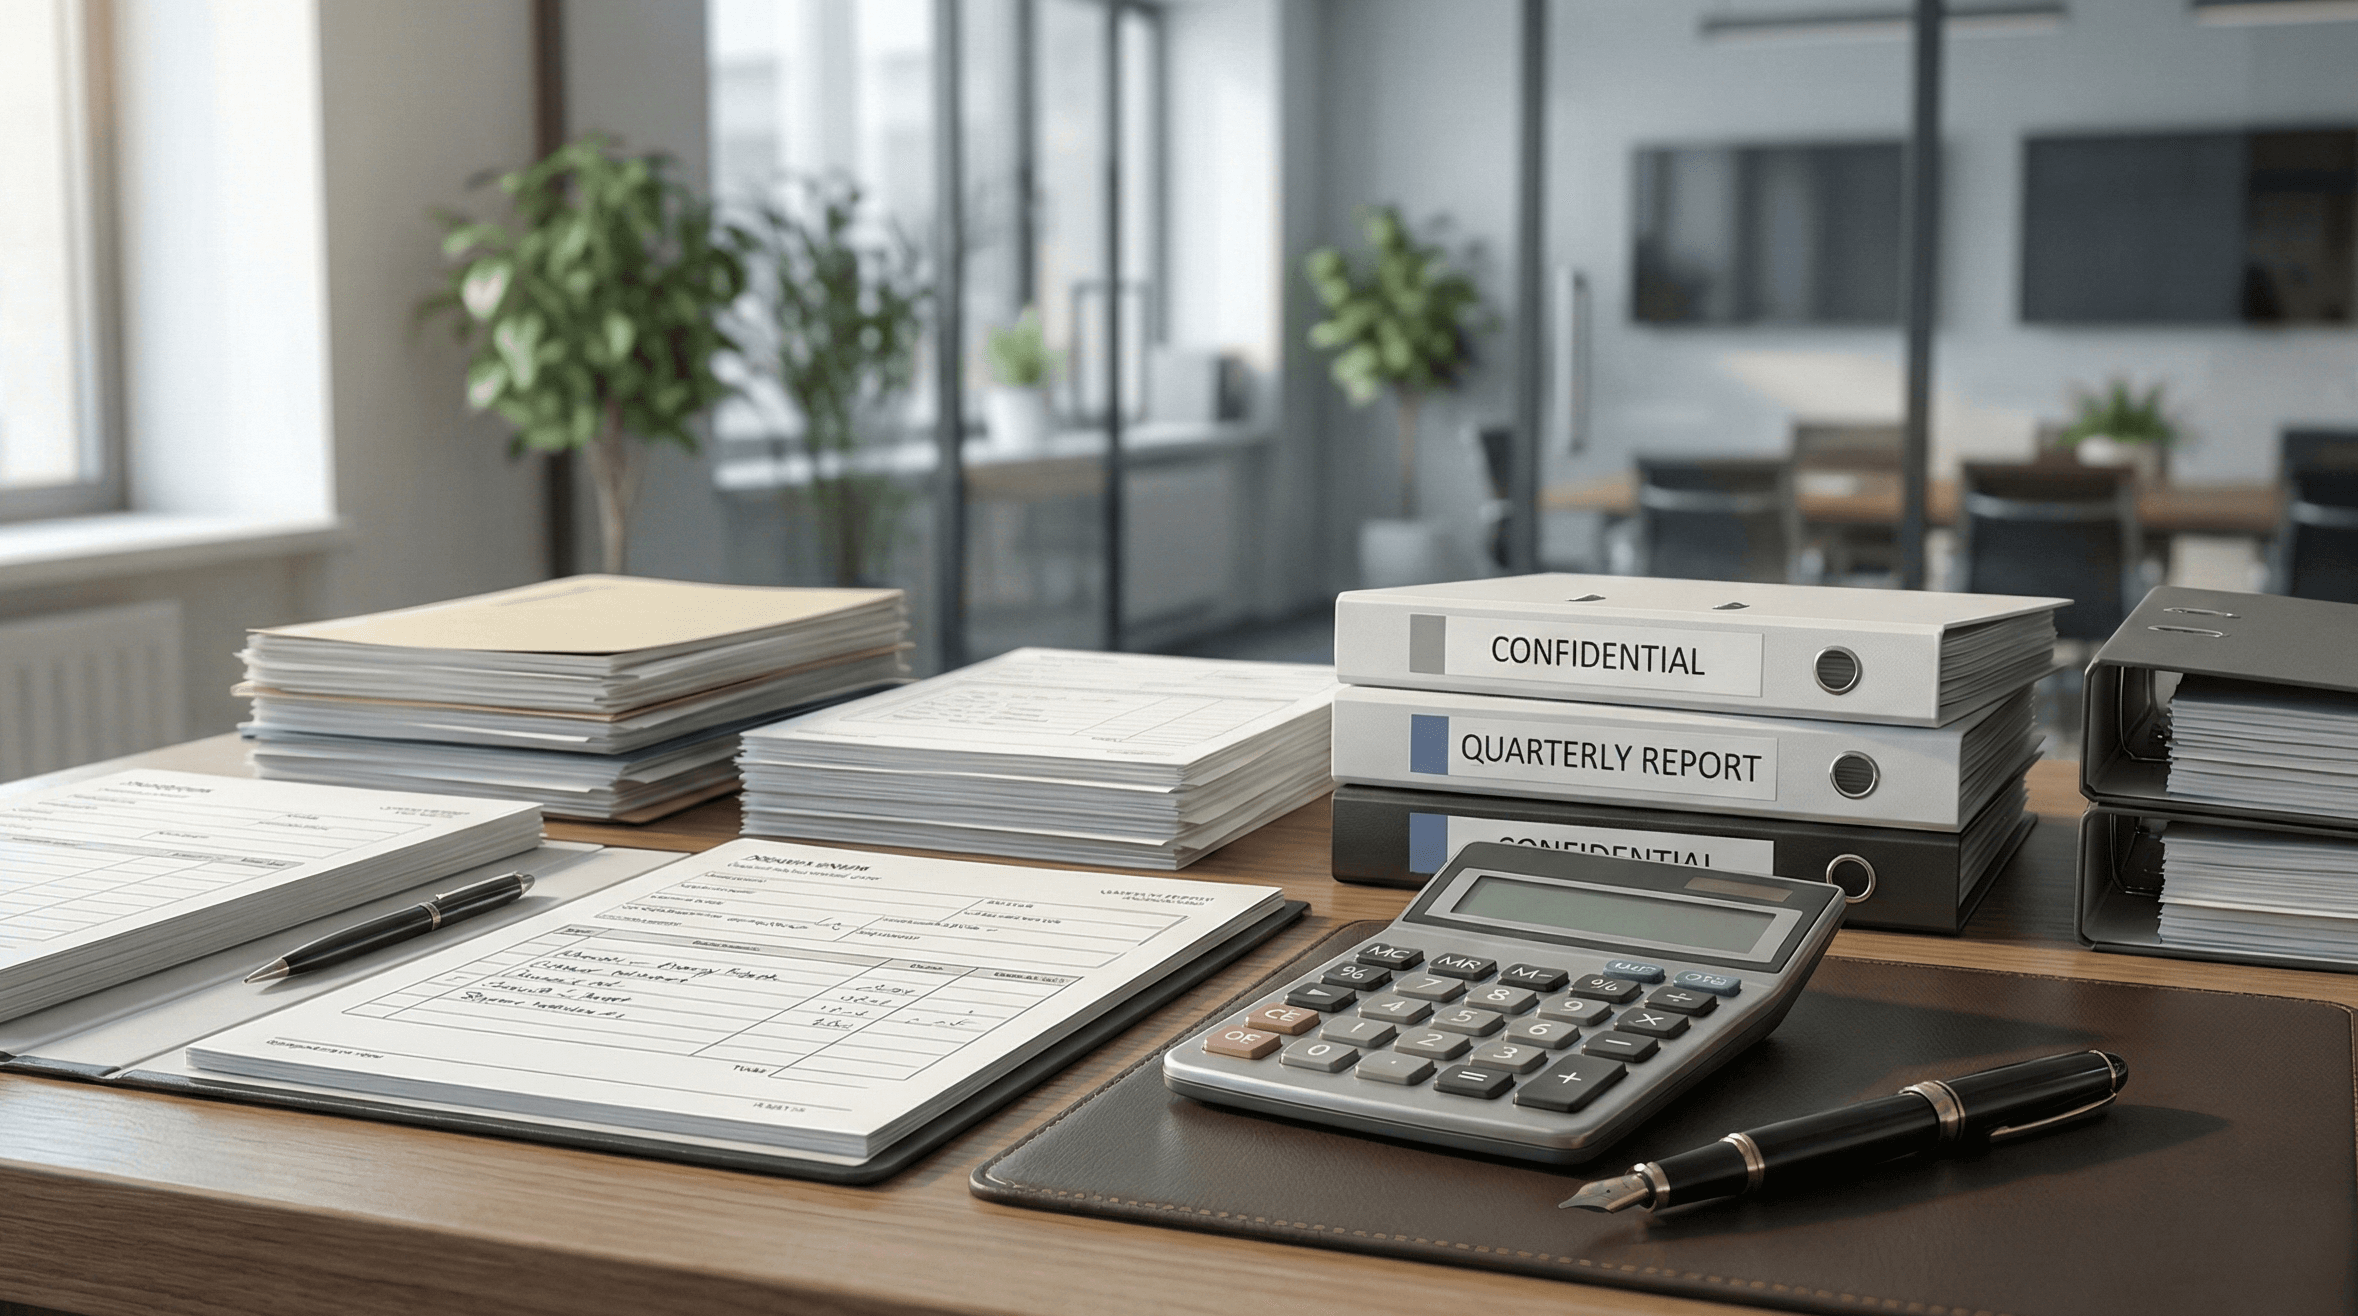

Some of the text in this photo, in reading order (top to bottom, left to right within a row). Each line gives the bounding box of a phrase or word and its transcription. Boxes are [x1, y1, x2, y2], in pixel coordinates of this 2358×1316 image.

[1492, 635, 1705, 676] CONFIDENTIAL
[1461, 733, 1762, 782] QUARTERLY REPORT
[1437, 956, 1481, 970] MR
[1416, 977, 1442, 989] 7
[1486, 989, 1510, 1001] 8
[1560, 1000, 1584, 1012] 9
[1264, 1008, 1301, 1022] CE
[1450, 1009, 1478, 1023] 5
[1528, 1023, 1552, 1036] 6
[1416, 1033, 1443, 1047] 2
[1307, 1044, 1331, 1056] 0
[1492, 1046, 1518, 1059] 3
